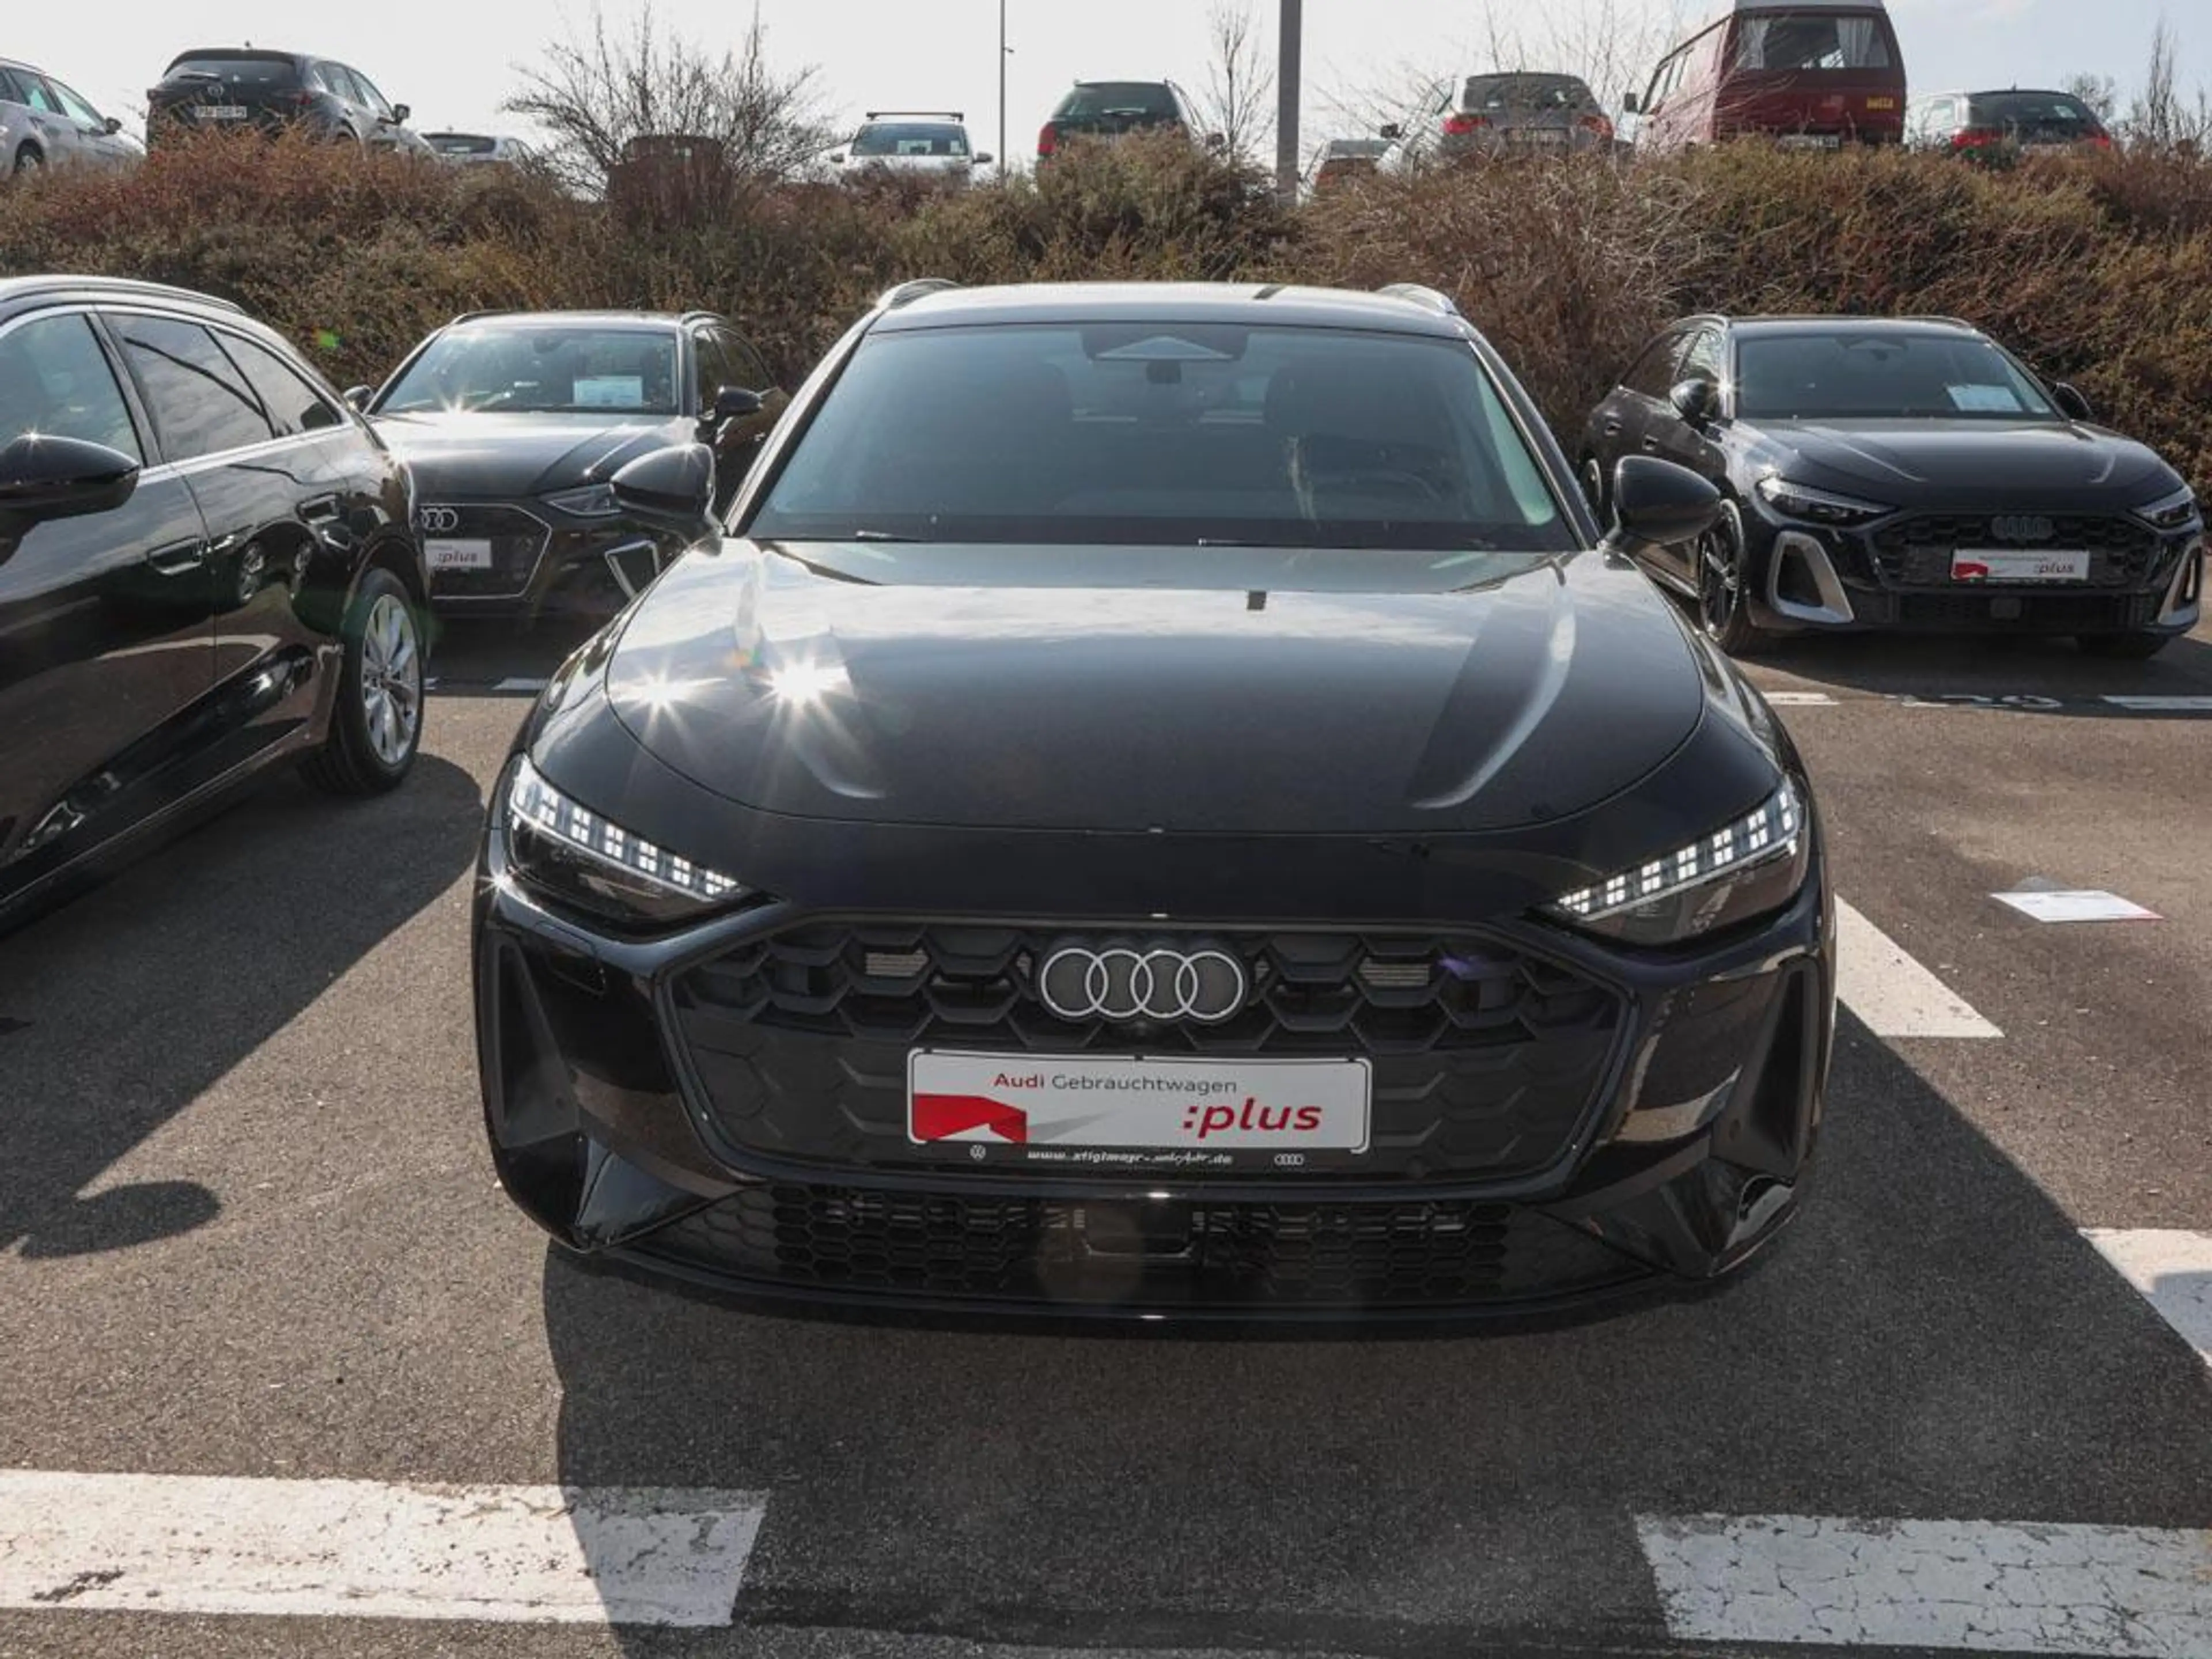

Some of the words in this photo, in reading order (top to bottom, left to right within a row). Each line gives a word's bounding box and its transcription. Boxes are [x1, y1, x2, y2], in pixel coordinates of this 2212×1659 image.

[993, 1073, 1044, 1089] Audi
[1051, 1074, 1237, 1095] Gebrauchtwagen
[1183, 1097, 1323, 1139] :plus
